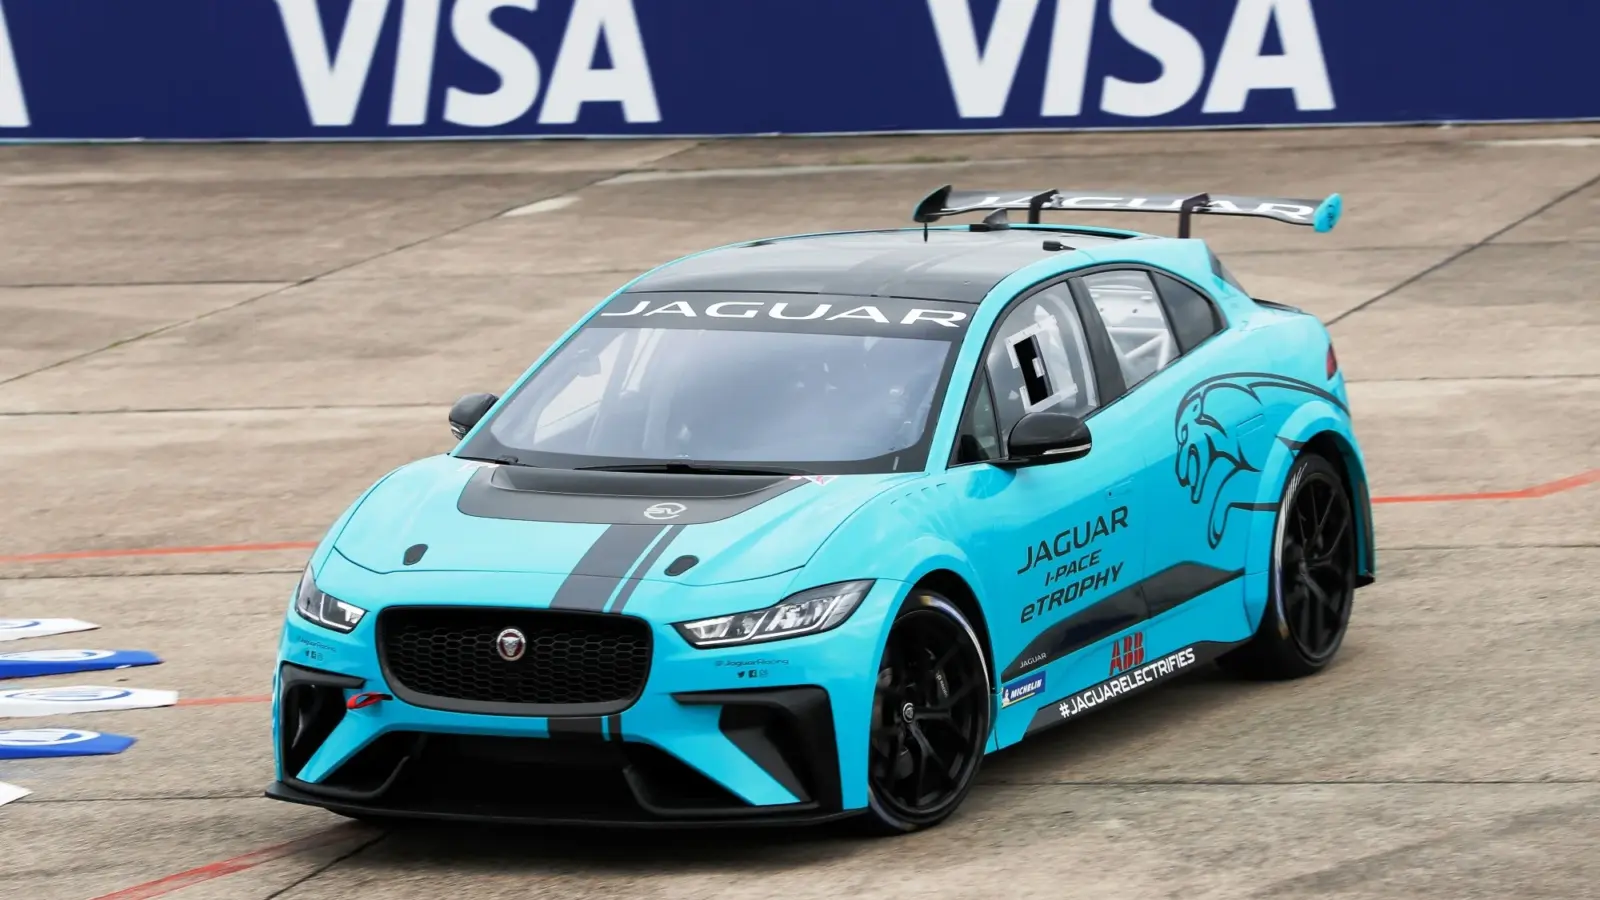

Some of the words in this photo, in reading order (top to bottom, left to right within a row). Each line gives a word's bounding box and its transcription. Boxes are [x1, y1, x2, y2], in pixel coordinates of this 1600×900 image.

[275, 0, 661, 126] VISA
[927, 0, 1336, 117] VISA
[601, 301, 967, 328] JAGUAR
[1017, 505, 1128, 575] JAGUAR
[1020, 561, 1124, 624] eTROPHY
[1044, 549, 1102, 587] I-PACE
[1019, 651, 1047, 669] JAGUAR
[1109, 631, 1145, 676] ABB
[1010, 678, 1043, 699] MICHELIN
[1059, 647, 1196, 718] #JAGUARELECTRIFIES
